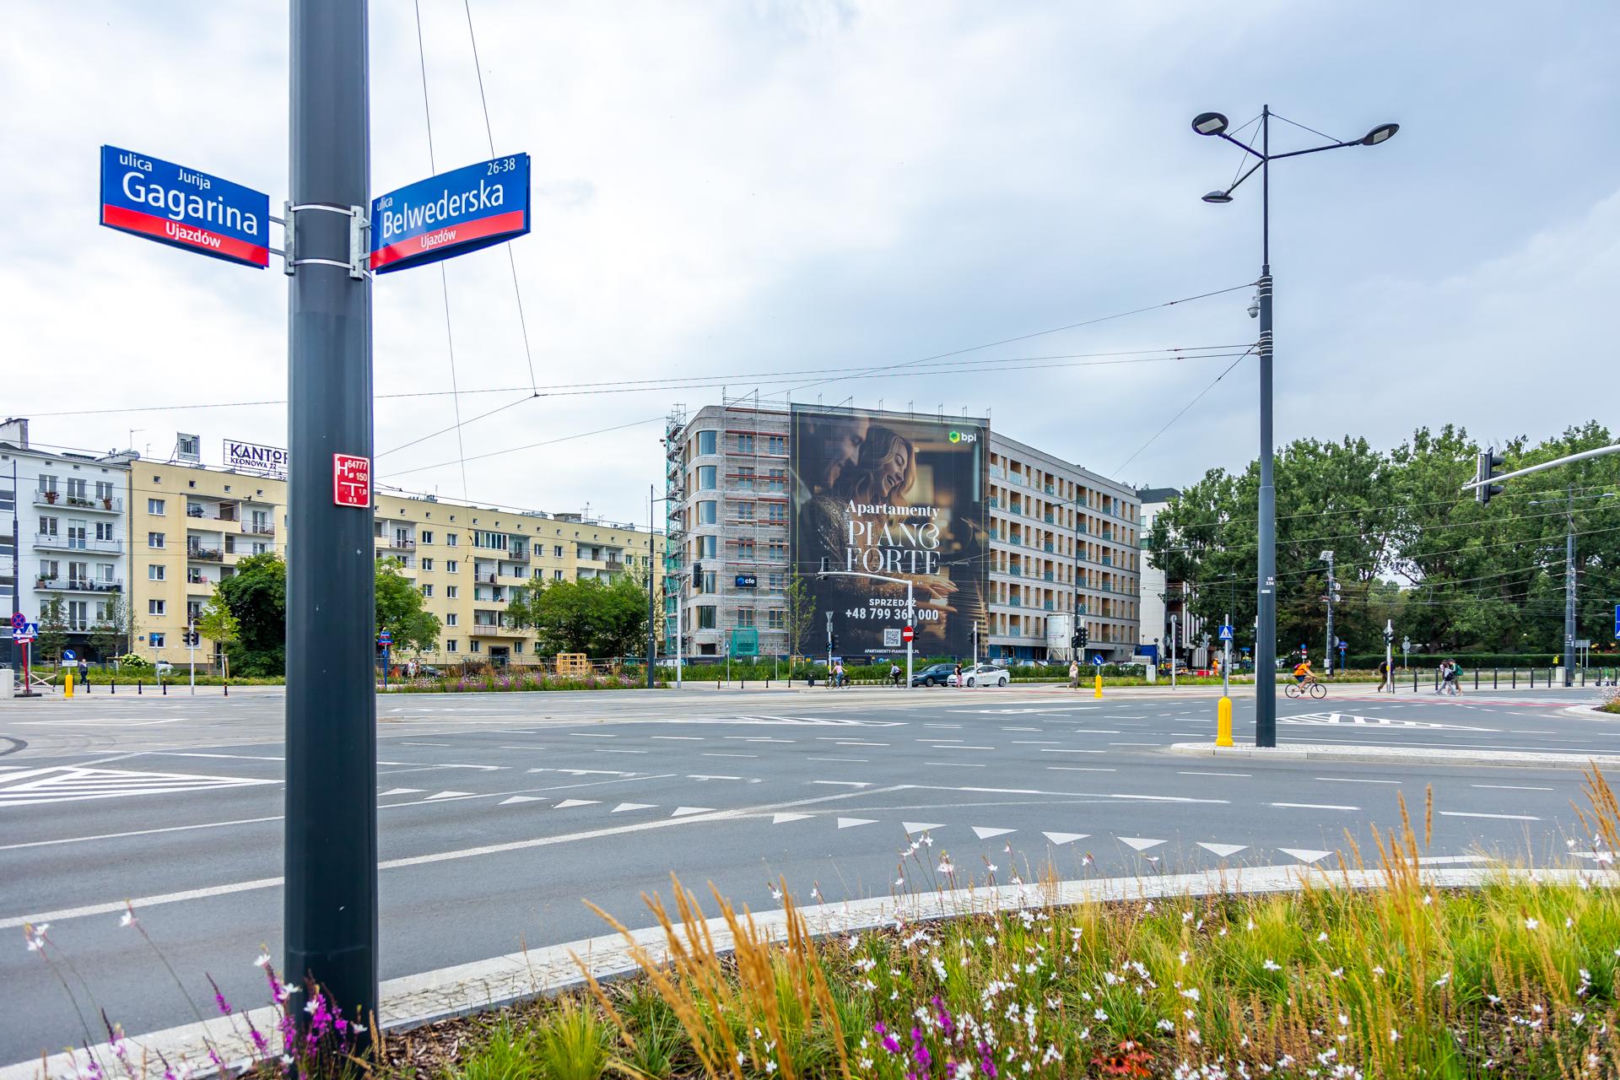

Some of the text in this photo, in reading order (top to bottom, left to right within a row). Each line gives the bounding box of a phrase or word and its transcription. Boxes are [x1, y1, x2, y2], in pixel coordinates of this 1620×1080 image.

[119, 153, 153, 172] ulica
[487, 157, 516, 176] 26-38
[178, 168, 211, 190] Jurija
[122, 171, 258, 236] Gagarina
[376, 196, 393, 211] ulica
[383, 179, 504, 239] Belwederska
[165, 221, 221, 248] Ujazdów
[420, 229, 456, 250] Ujazdów
[961, 431, 977, 443] bpi
[845, 499, 940, 520] Apartamenty
[847, 520, 940, 550] PIANO
[845, 547, 941, 575] FORTE
[845, 607, 866, 619] +48
[870, 608, 891, 620] 799
[918, 609, 939, 621] 000
